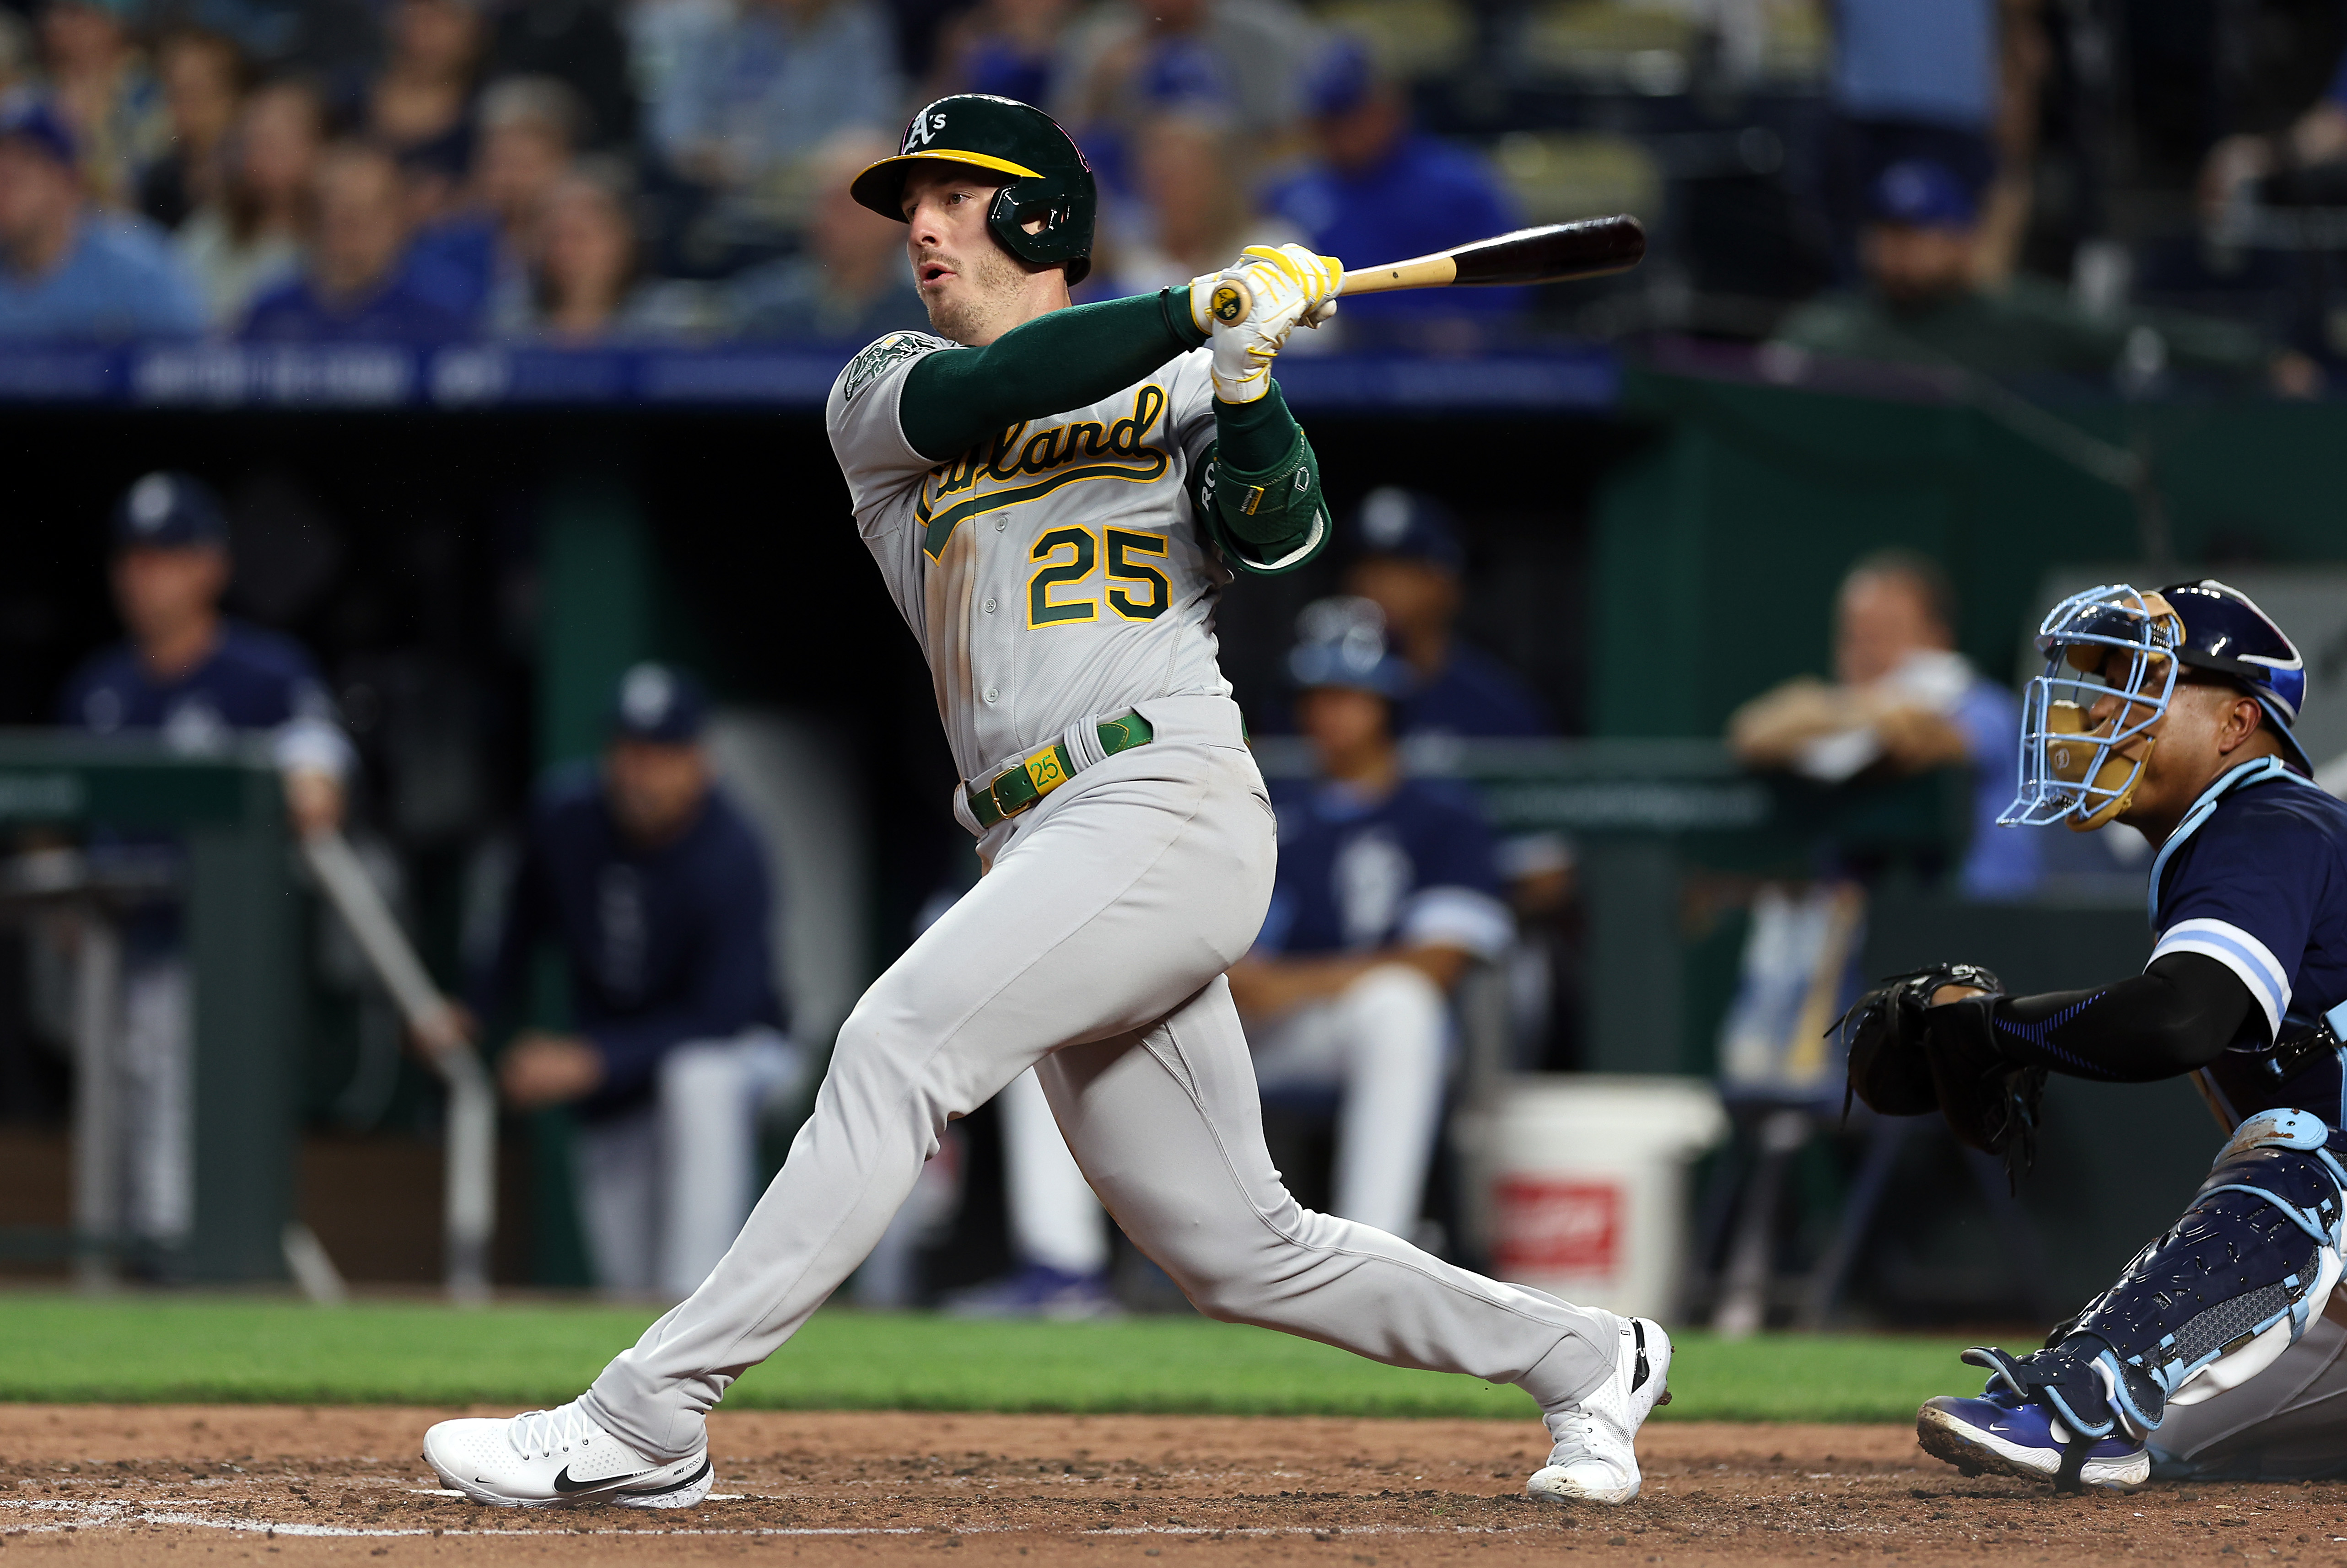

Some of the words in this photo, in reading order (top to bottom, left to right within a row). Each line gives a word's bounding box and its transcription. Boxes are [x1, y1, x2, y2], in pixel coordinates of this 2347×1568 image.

[903, 110, 947, 155] A's
[1026, 523, 1173, 631] 25
[1030, 755, 1058, 787] 25
[673, 1466, 685, 1477] NIKE
